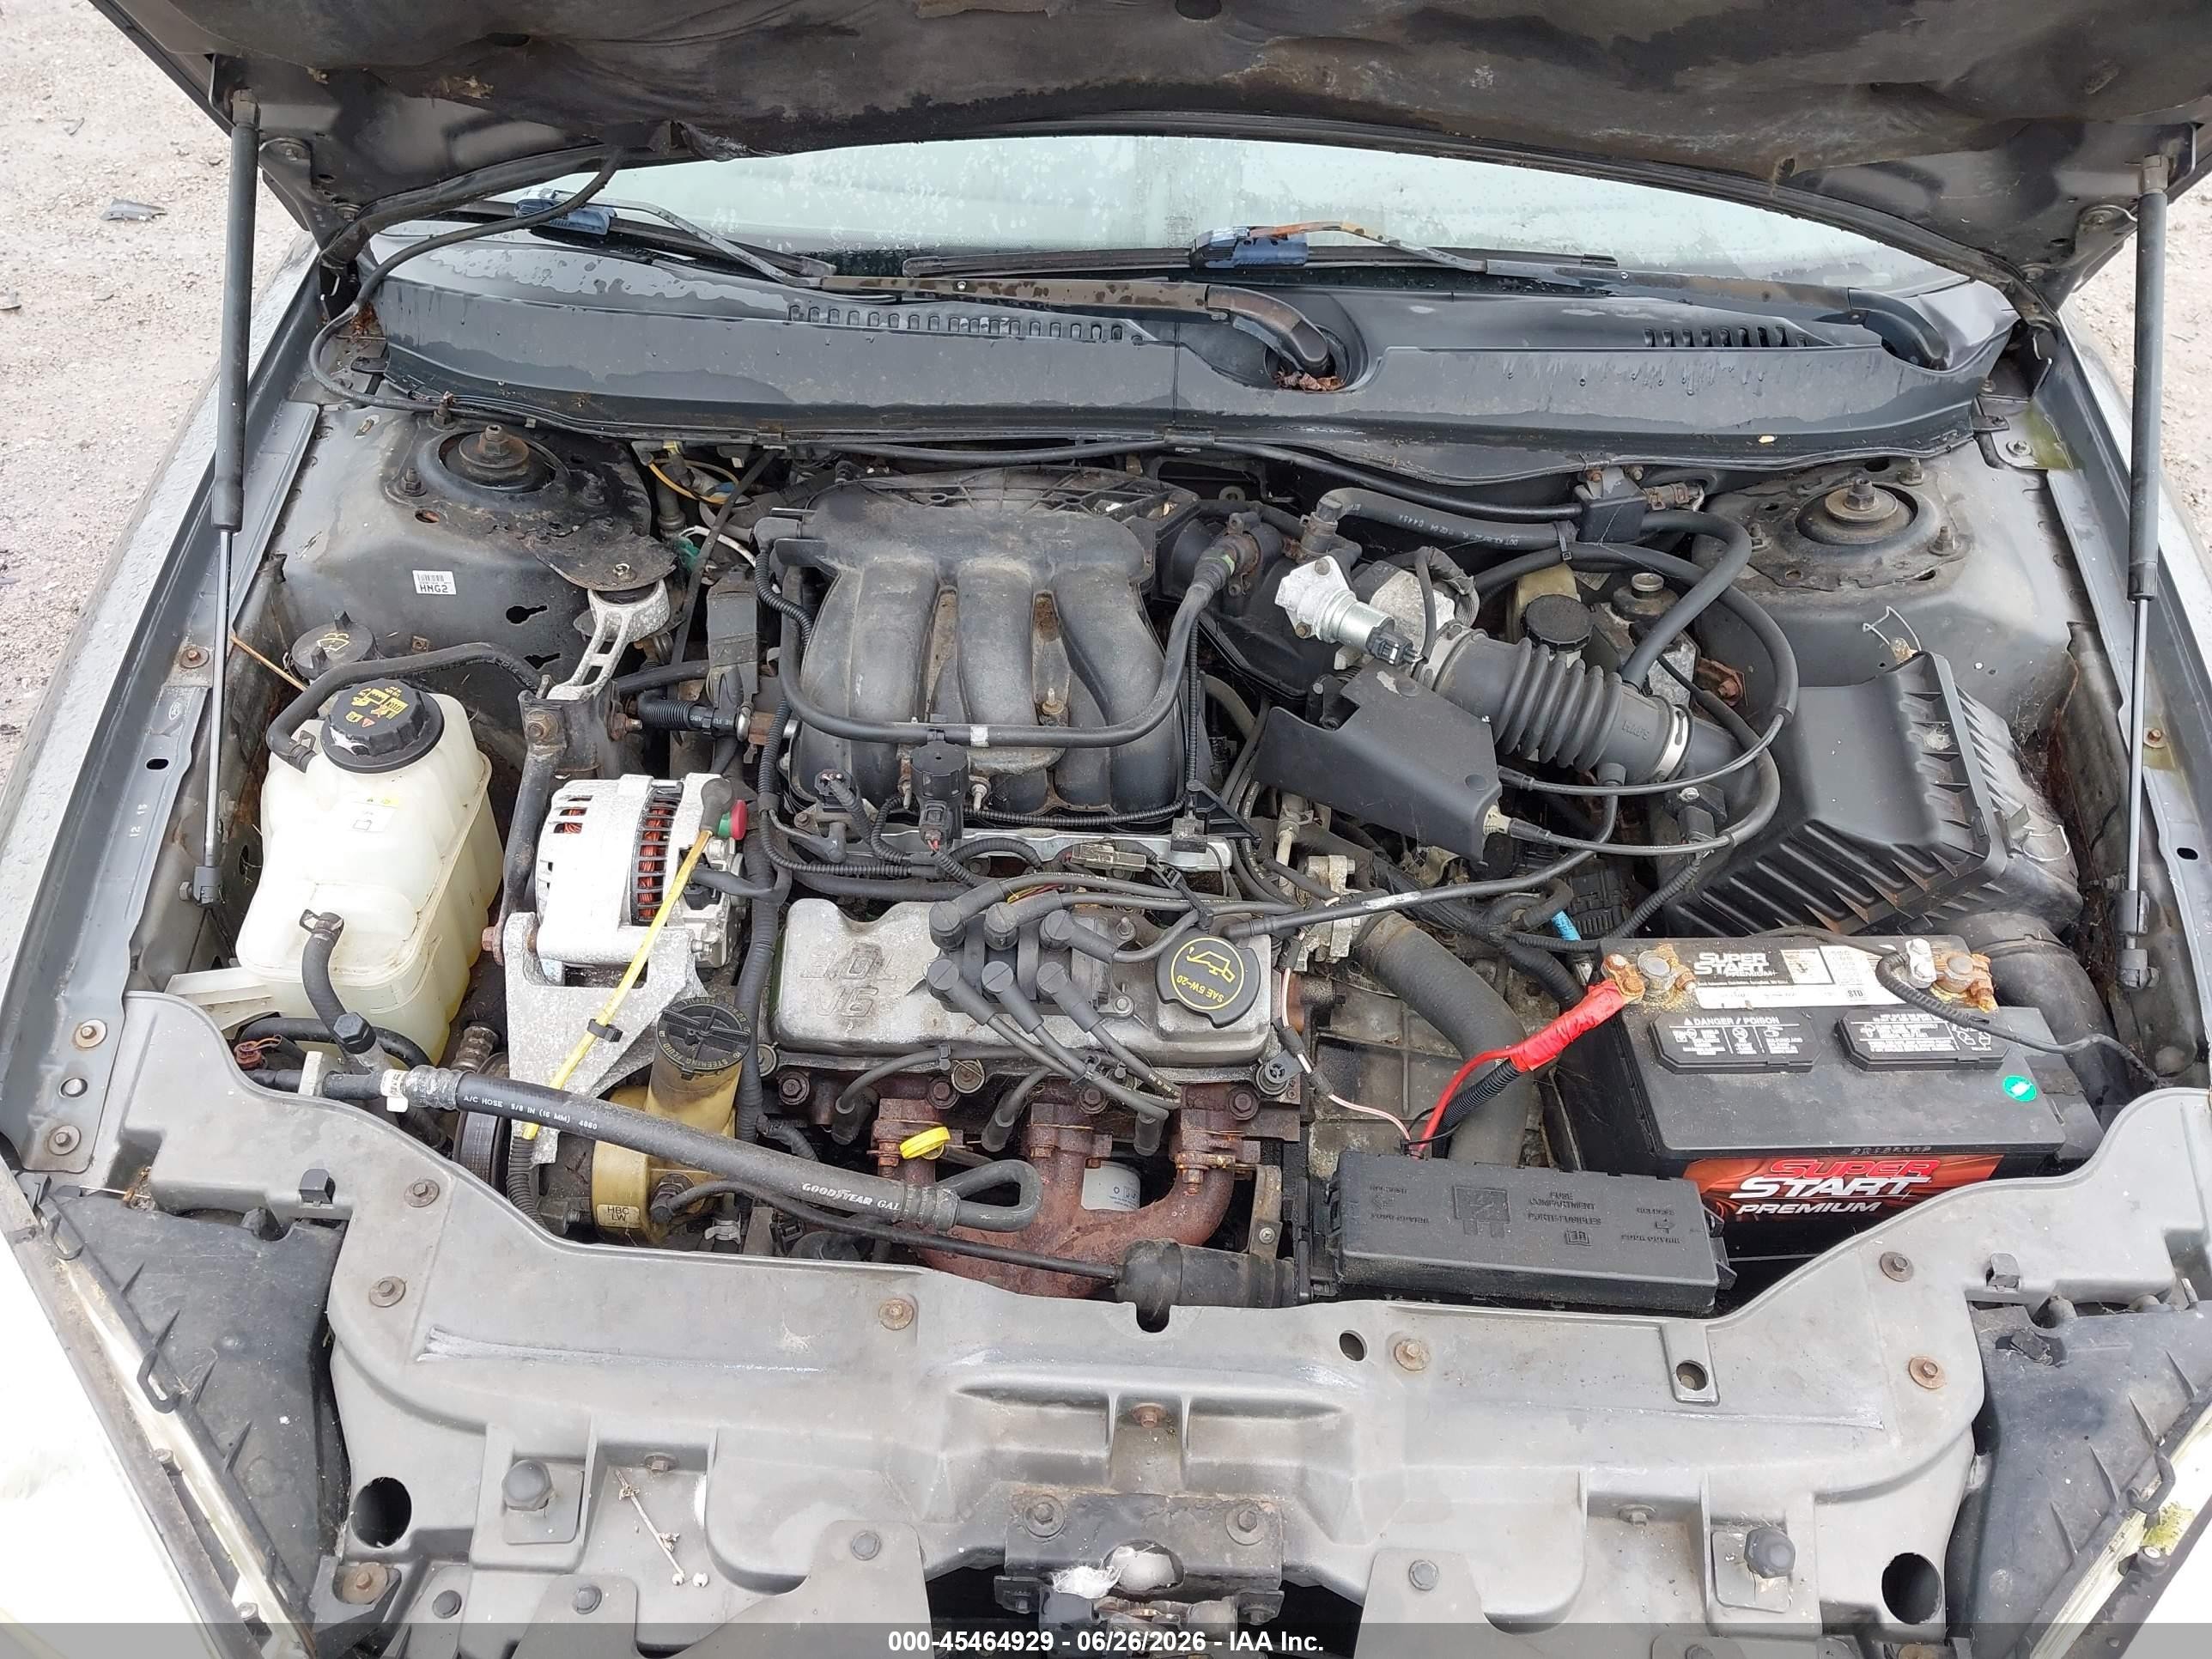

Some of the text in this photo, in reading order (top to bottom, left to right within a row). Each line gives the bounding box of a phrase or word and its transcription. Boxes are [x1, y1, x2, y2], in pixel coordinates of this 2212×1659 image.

[1698, 951, 1767, 964] SUPER
[1693, 962, 1770, 975] START
[1176, 975, 1224, 1003] SAE 5W-20
[813, 986, 879, 1018] V6
[1693, 1017, 1735, 1026] DANGER
[1743, 1016, 1781, 1024] POISON
[662, 1042, 728, 1069] STEERING FLUID
[463, 1095, 479, 1104] A/C
[481, 1097, 503, 1109] HOSE
[510, 1103, 525, 1113] 5/8
[526, 1106, 536, 1115] IN
[553, 1113, 571, 1124] MM)
[1763, 1158, 1941, 1179] SUPER
[801, 1182, 873, 1206] GOODYEAR
[1729, 1176, 1931, 1200] START
[607, 1206, 630, 1215] HBC
[1528, 1197, 1596, 1211] COMPARTMENT
[1735, 1201, 1884, 1215] PREMIUM
[611, 1212, 627, 1222] LW
